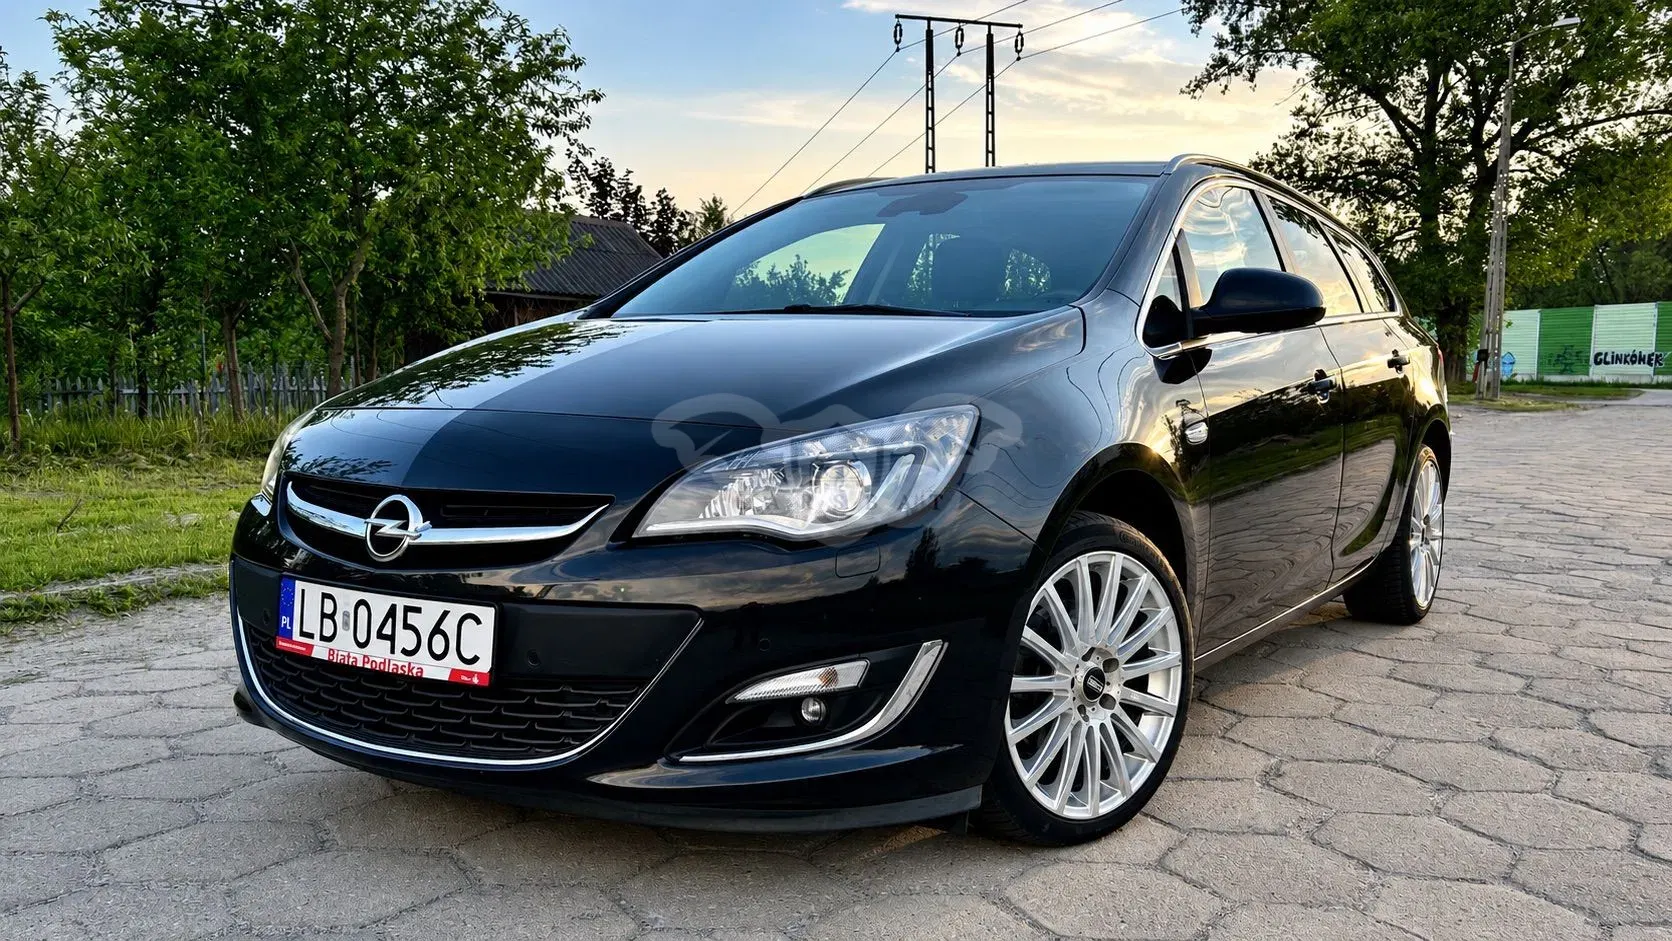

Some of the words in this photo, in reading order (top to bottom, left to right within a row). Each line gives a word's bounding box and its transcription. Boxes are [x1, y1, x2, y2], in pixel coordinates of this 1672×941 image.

[281, 616, 291, 630] PL
[299, 588, 338, 643] LB
[353, 598, 483, 665] 0456C
[362, 654, 424, 678] Podlaska
